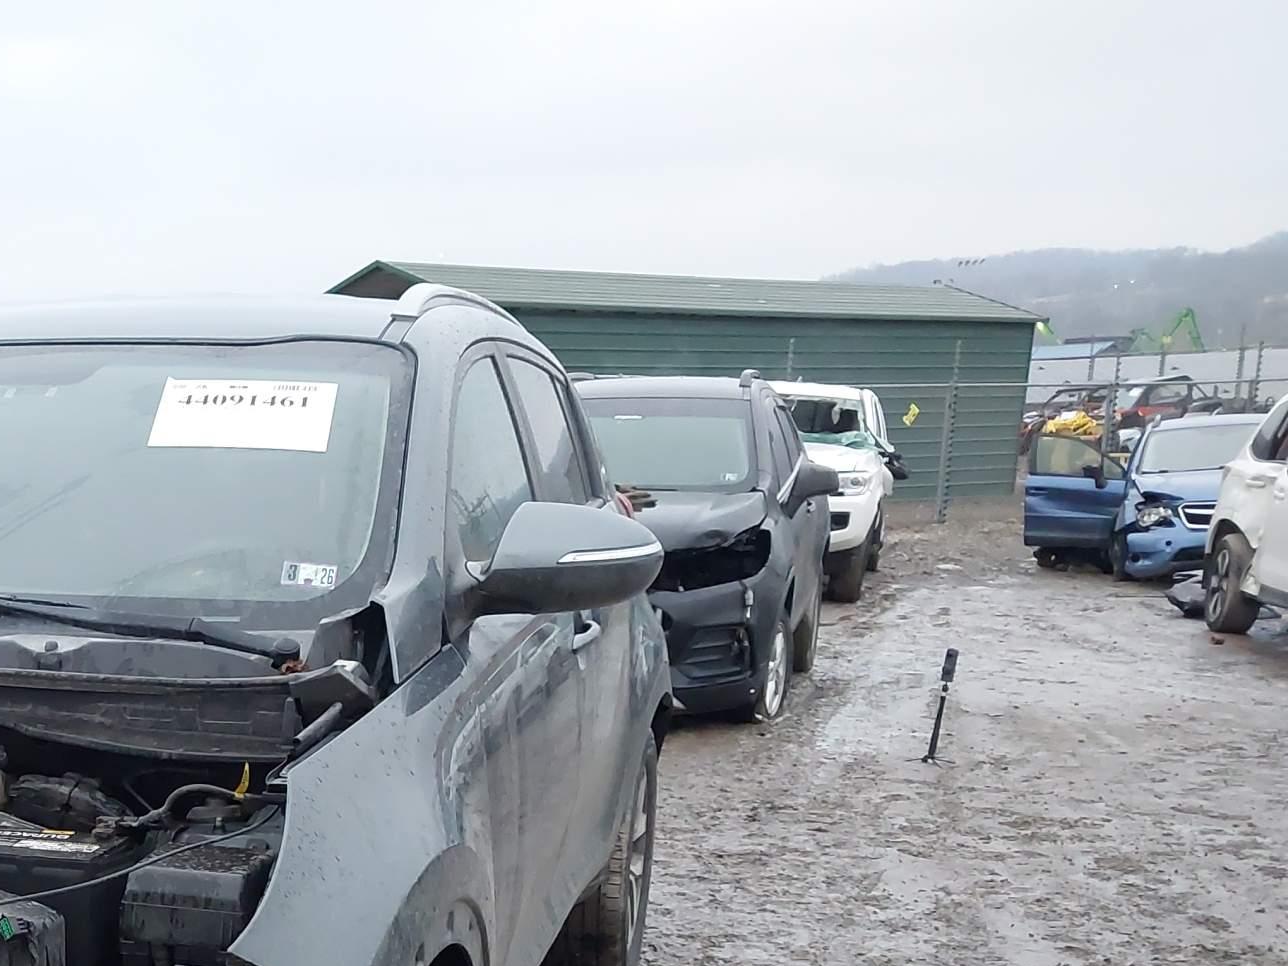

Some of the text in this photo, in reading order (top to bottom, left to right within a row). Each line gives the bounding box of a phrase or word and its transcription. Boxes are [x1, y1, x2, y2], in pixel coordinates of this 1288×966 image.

[178, 394, 308, 408] 44091461
[287, 564, 335, 585] 3 26
